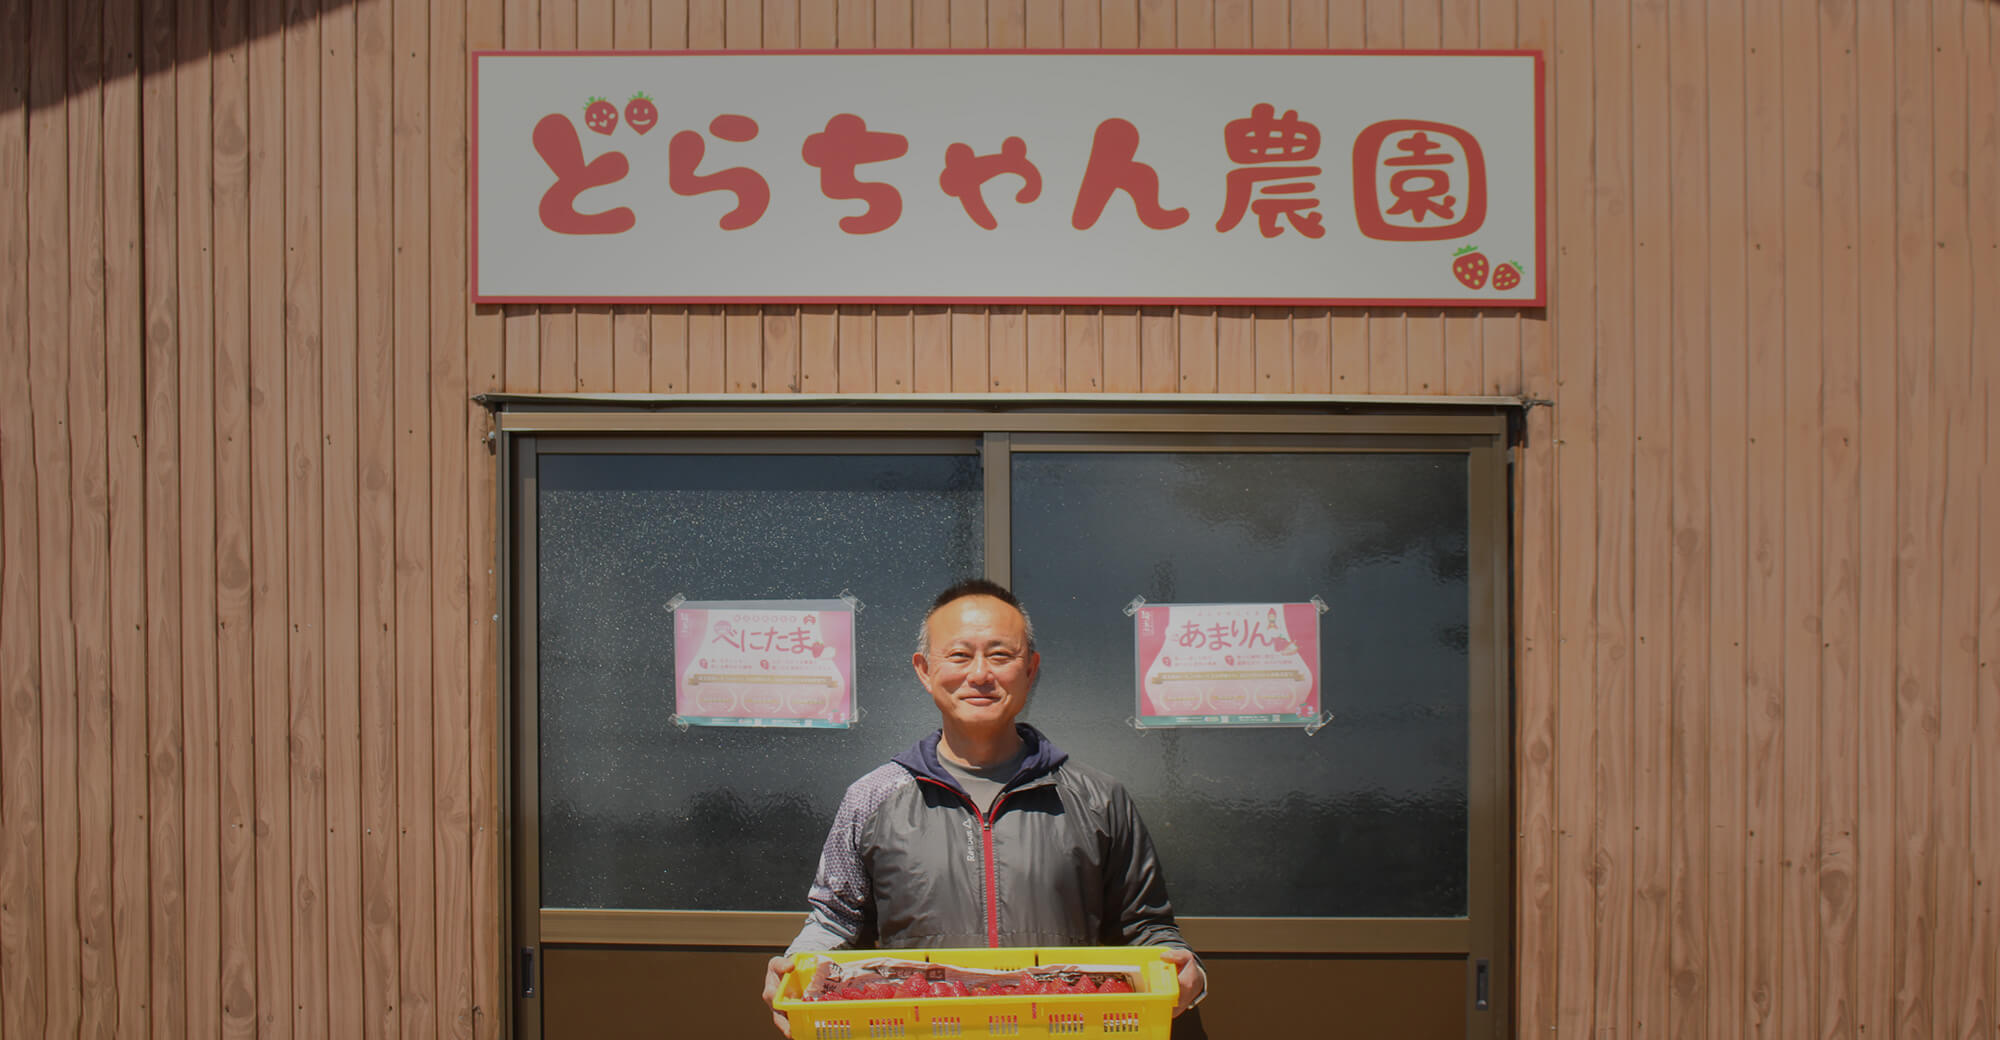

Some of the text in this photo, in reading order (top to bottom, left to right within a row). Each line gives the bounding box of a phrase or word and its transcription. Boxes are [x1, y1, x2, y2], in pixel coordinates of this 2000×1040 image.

[531, 97, 1488, 242] どらちゃん農園
[712, 627, 814, 654] べにたま
[1179, 619, 1272, 651] あまりん
